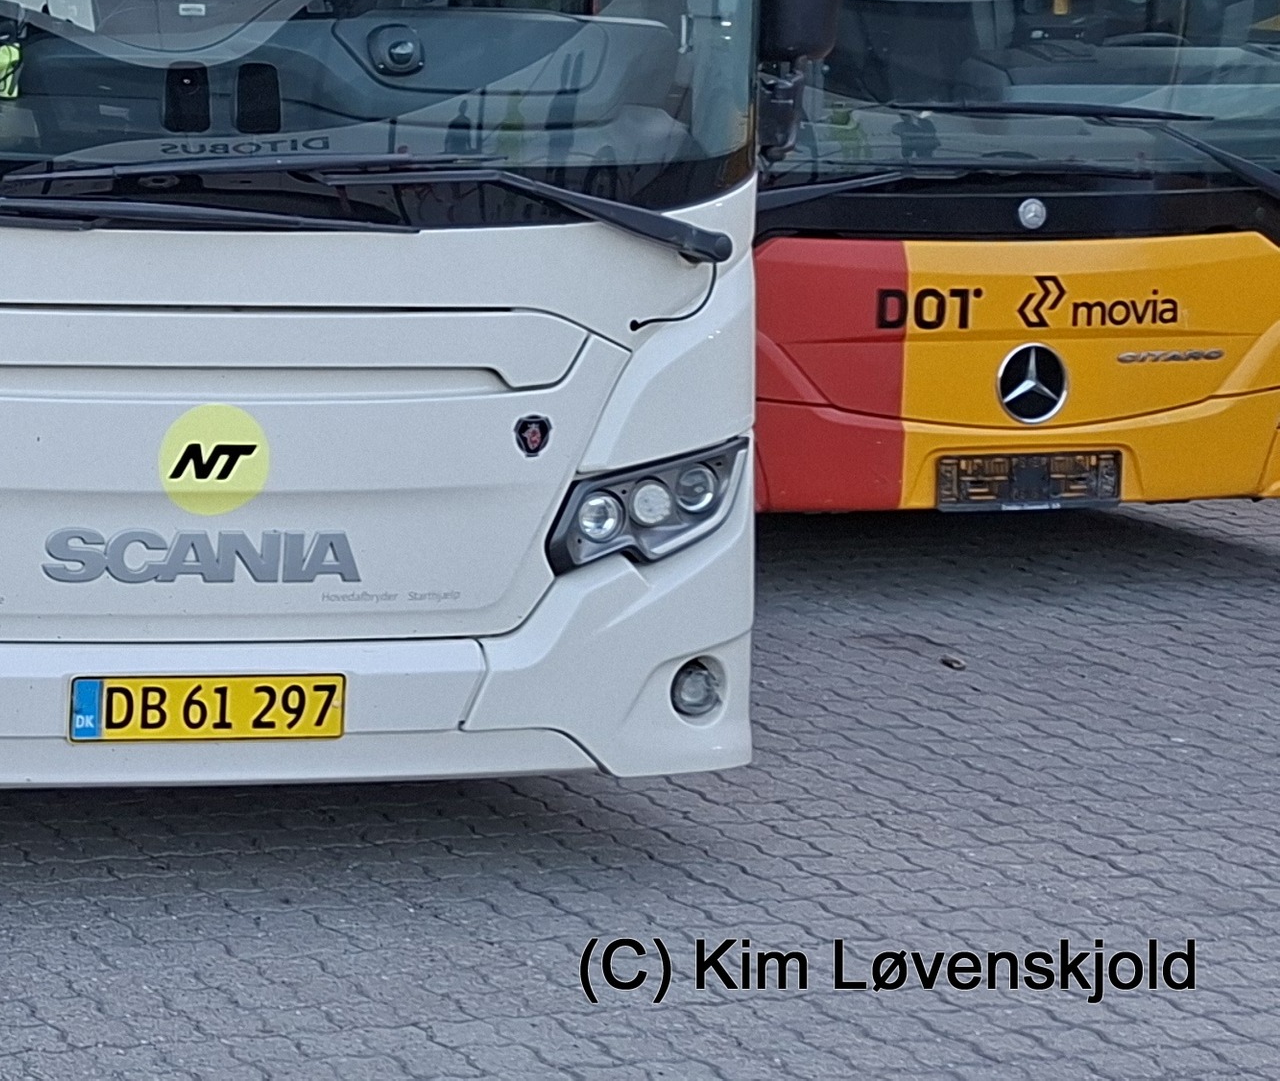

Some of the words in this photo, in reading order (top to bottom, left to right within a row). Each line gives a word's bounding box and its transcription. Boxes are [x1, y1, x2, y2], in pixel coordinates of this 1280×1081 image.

[876, 287, 984, 331] DOT
[1072, 288, 1180, 327] movia
[168, 442, 259, 481] NT
[41, 527, 362, 584] SCANIA
[75, 714, 95, 729] DK
[105, 686, 167, 730] DB
[183, 684, 232, 730] 61
[252, 684, 338, 730] 297
